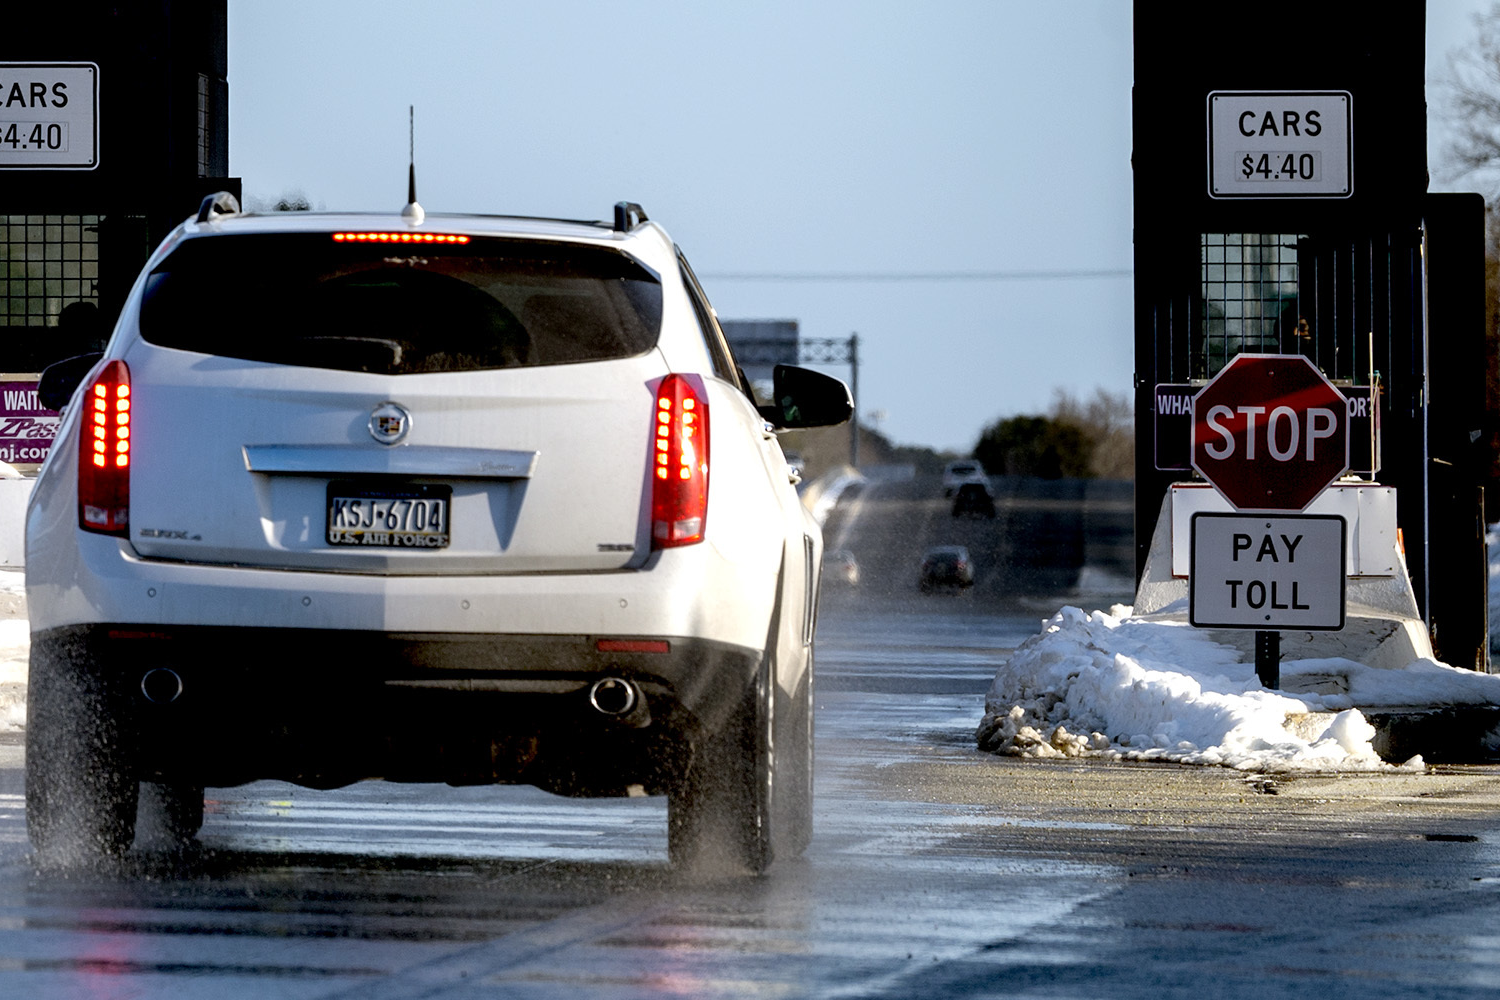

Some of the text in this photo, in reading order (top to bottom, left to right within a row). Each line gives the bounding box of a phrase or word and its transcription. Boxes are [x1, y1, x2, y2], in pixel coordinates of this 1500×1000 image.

[1238, 110, 1323, 138] CARS
[1241, 153, 1315, 181] $4.40
[1203, 404, 1338, 463] STOP
[329, 530, 449, 548] U.S. AIR FORCE
[1232, 533, 1304, 564] PAY
[1225, 579, 1310, 611] TOLL
